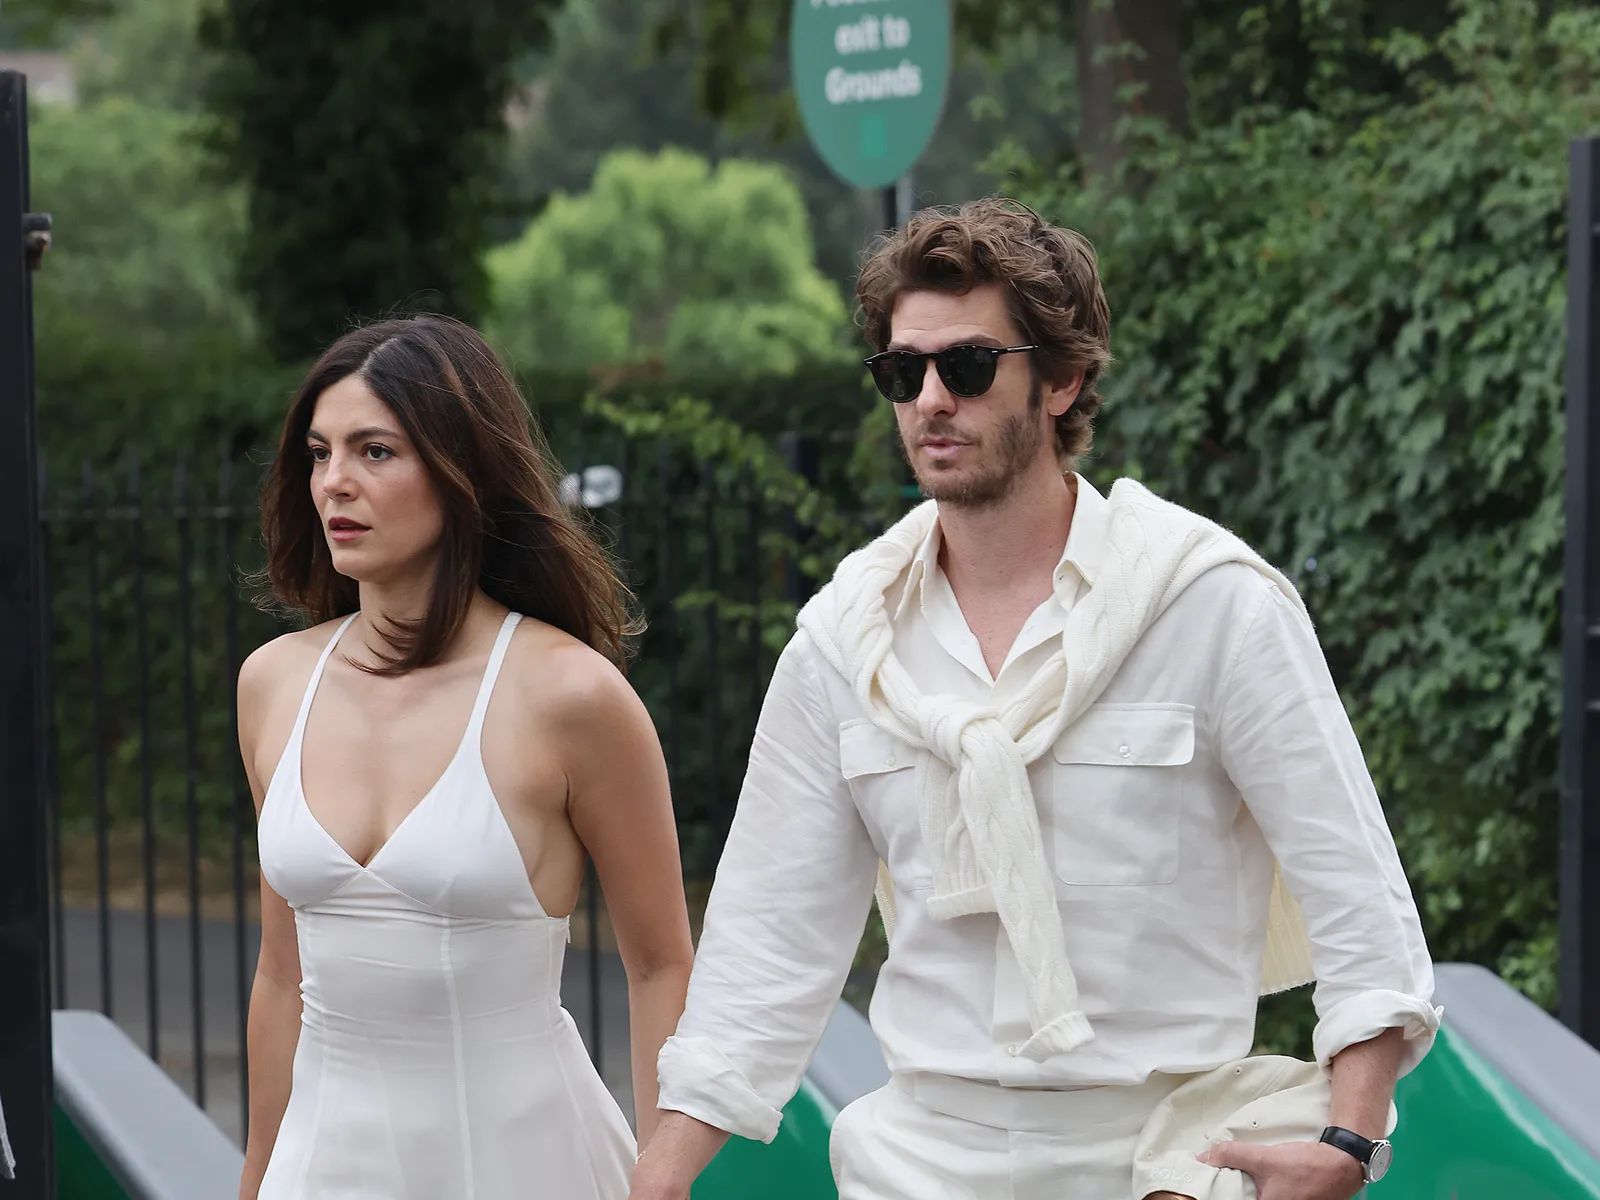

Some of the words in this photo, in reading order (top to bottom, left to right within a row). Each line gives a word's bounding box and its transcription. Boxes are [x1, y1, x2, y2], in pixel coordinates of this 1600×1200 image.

[882, 14, 910, 49] to
[825, 59, 922, 104] Grounds
[1149, 1166, 1193, 1183] POLO
